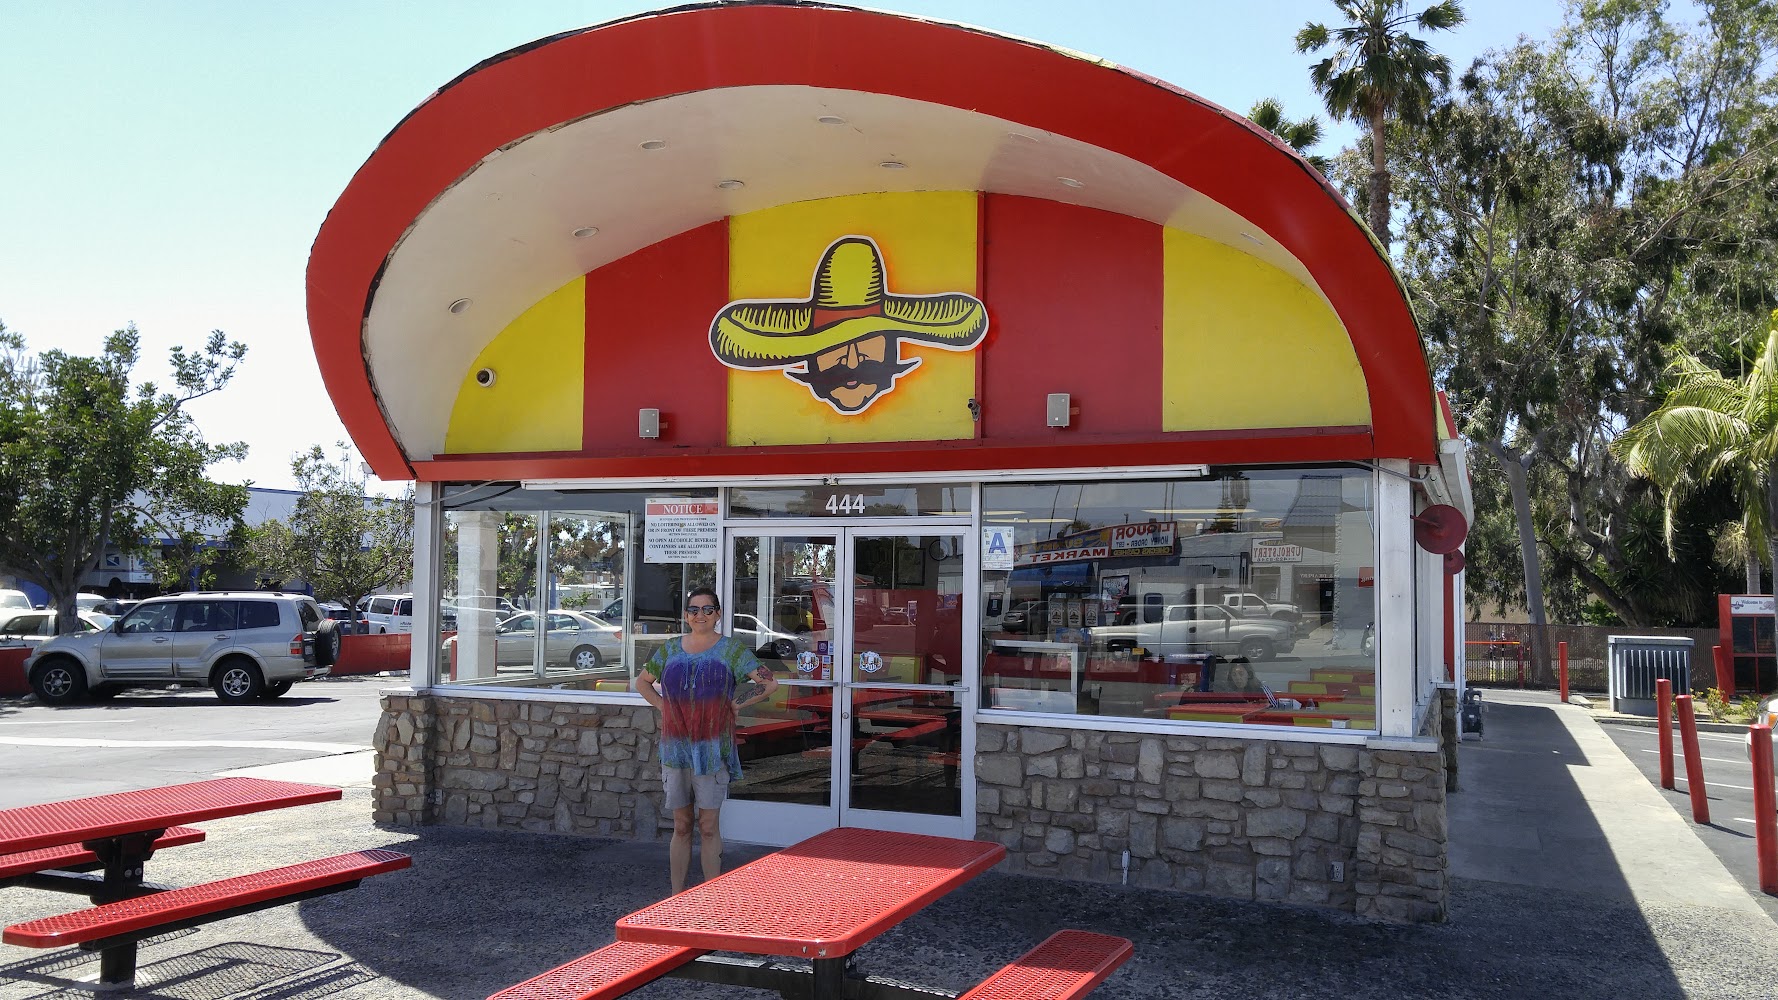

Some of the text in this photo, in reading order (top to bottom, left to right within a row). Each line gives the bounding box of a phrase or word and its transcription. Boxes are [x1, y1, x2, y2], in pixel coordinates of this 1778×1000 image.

[663, 504, 703, 514] NOTICE
[825, 493, 865, 514] 444
[988, 532, 1007, 554] A
